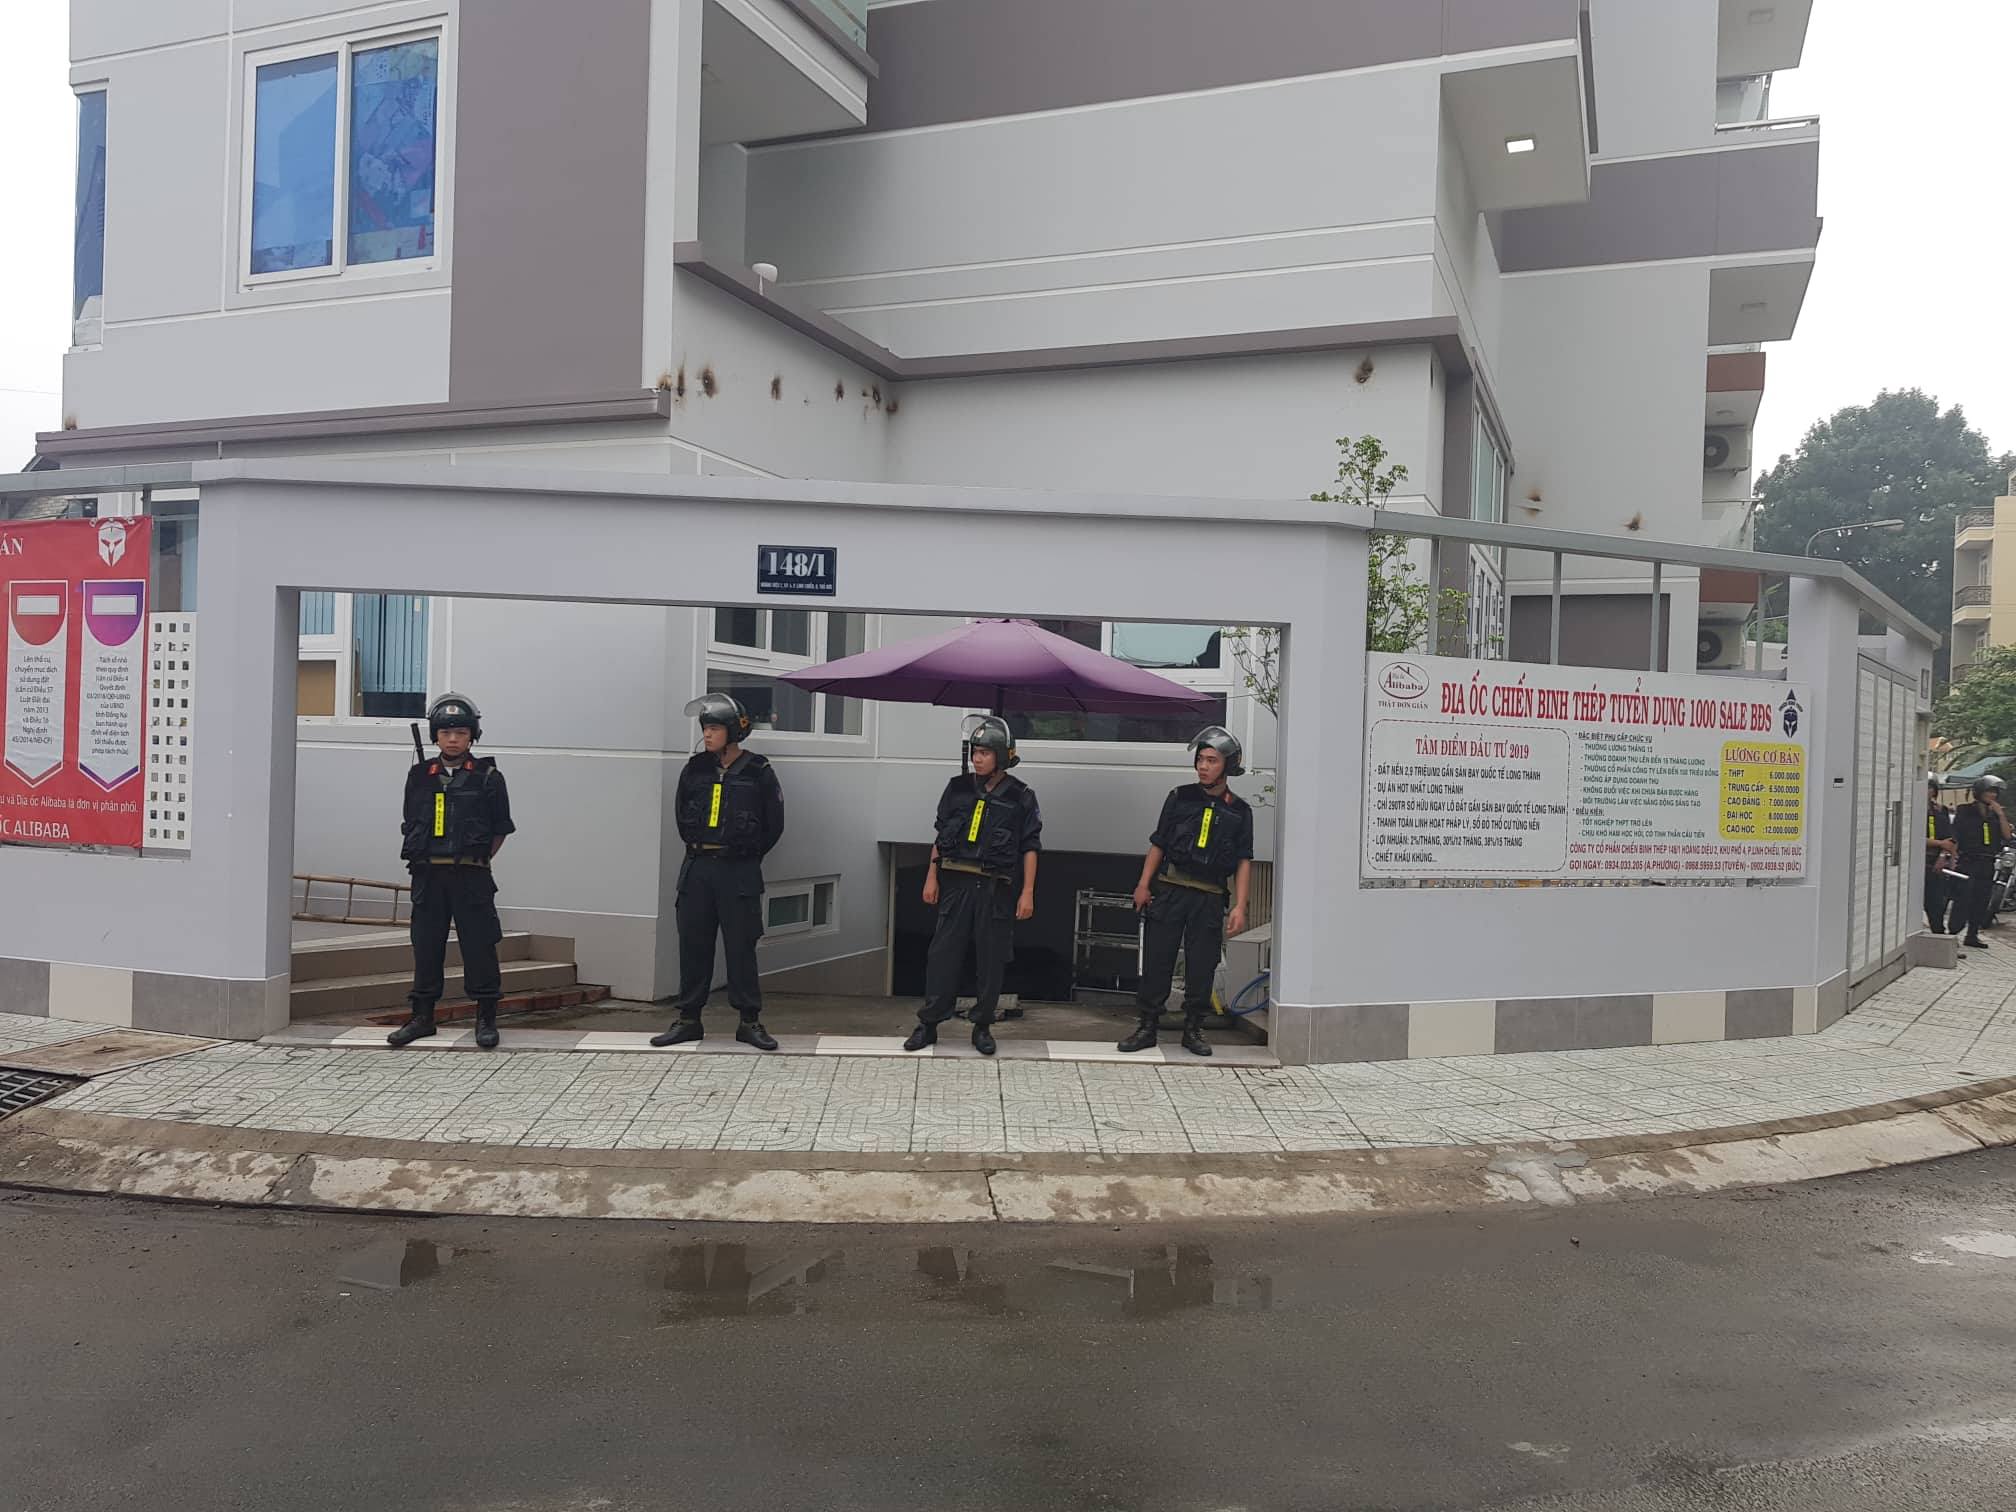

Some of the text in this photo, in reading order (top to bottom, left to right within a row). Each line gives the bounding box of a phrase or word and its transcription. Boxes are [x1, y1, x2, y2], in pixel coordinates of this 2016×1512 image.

[768, 552, 826, 577] 148/1
[1384, 671, 1423, 690] Alibaba
[1441, 669, 1772, 733] ĐỊA ỐC CHIẾN BINH THÉP TUYỂN DỤNG 1000 SALE BĐS
[1416, 732, 1529, 759] TÂM ĐIỂM ĐẦU TƯ 2019
[1726, 747, 1800, 763] LƯƠNG CƠ BẢN
[1468, 768, 1479, 778] BAY
[1506, 769, 1521, 780] LONG
[1728, 769, 1744, 777] THPT
[1397, 783, 1409, 793] HOT
[1427, 783, 1443, 794] LONG
[1728, 783, 1749, 792] TRUNG
[41, 796, 66, 808] Alibaba
[1727, 797, 1741, 806] CAO
[1430, 801, 1445, 811] NGAY
[1494, 803, 1506, 813] BAY
[1532, 804, 1547, 814] LONG
[1727, 810, 1738, 820] ĐẠI
[1739, 811, 1753, 821] HỌC
[1377, 817, 1396, 828] THANH
[1415, 818, 1428, 828] LINH
[14, 820, 70, 839] ALIBABA
[1726, 824, 1740, 833] CAO
[1741, 825, 1755, 834] HỌC
[1588, 844, 1595, 853] TY
[1640, 844, 1652, 853] BINH
[1569, 860, 1582, 871] GỌI
